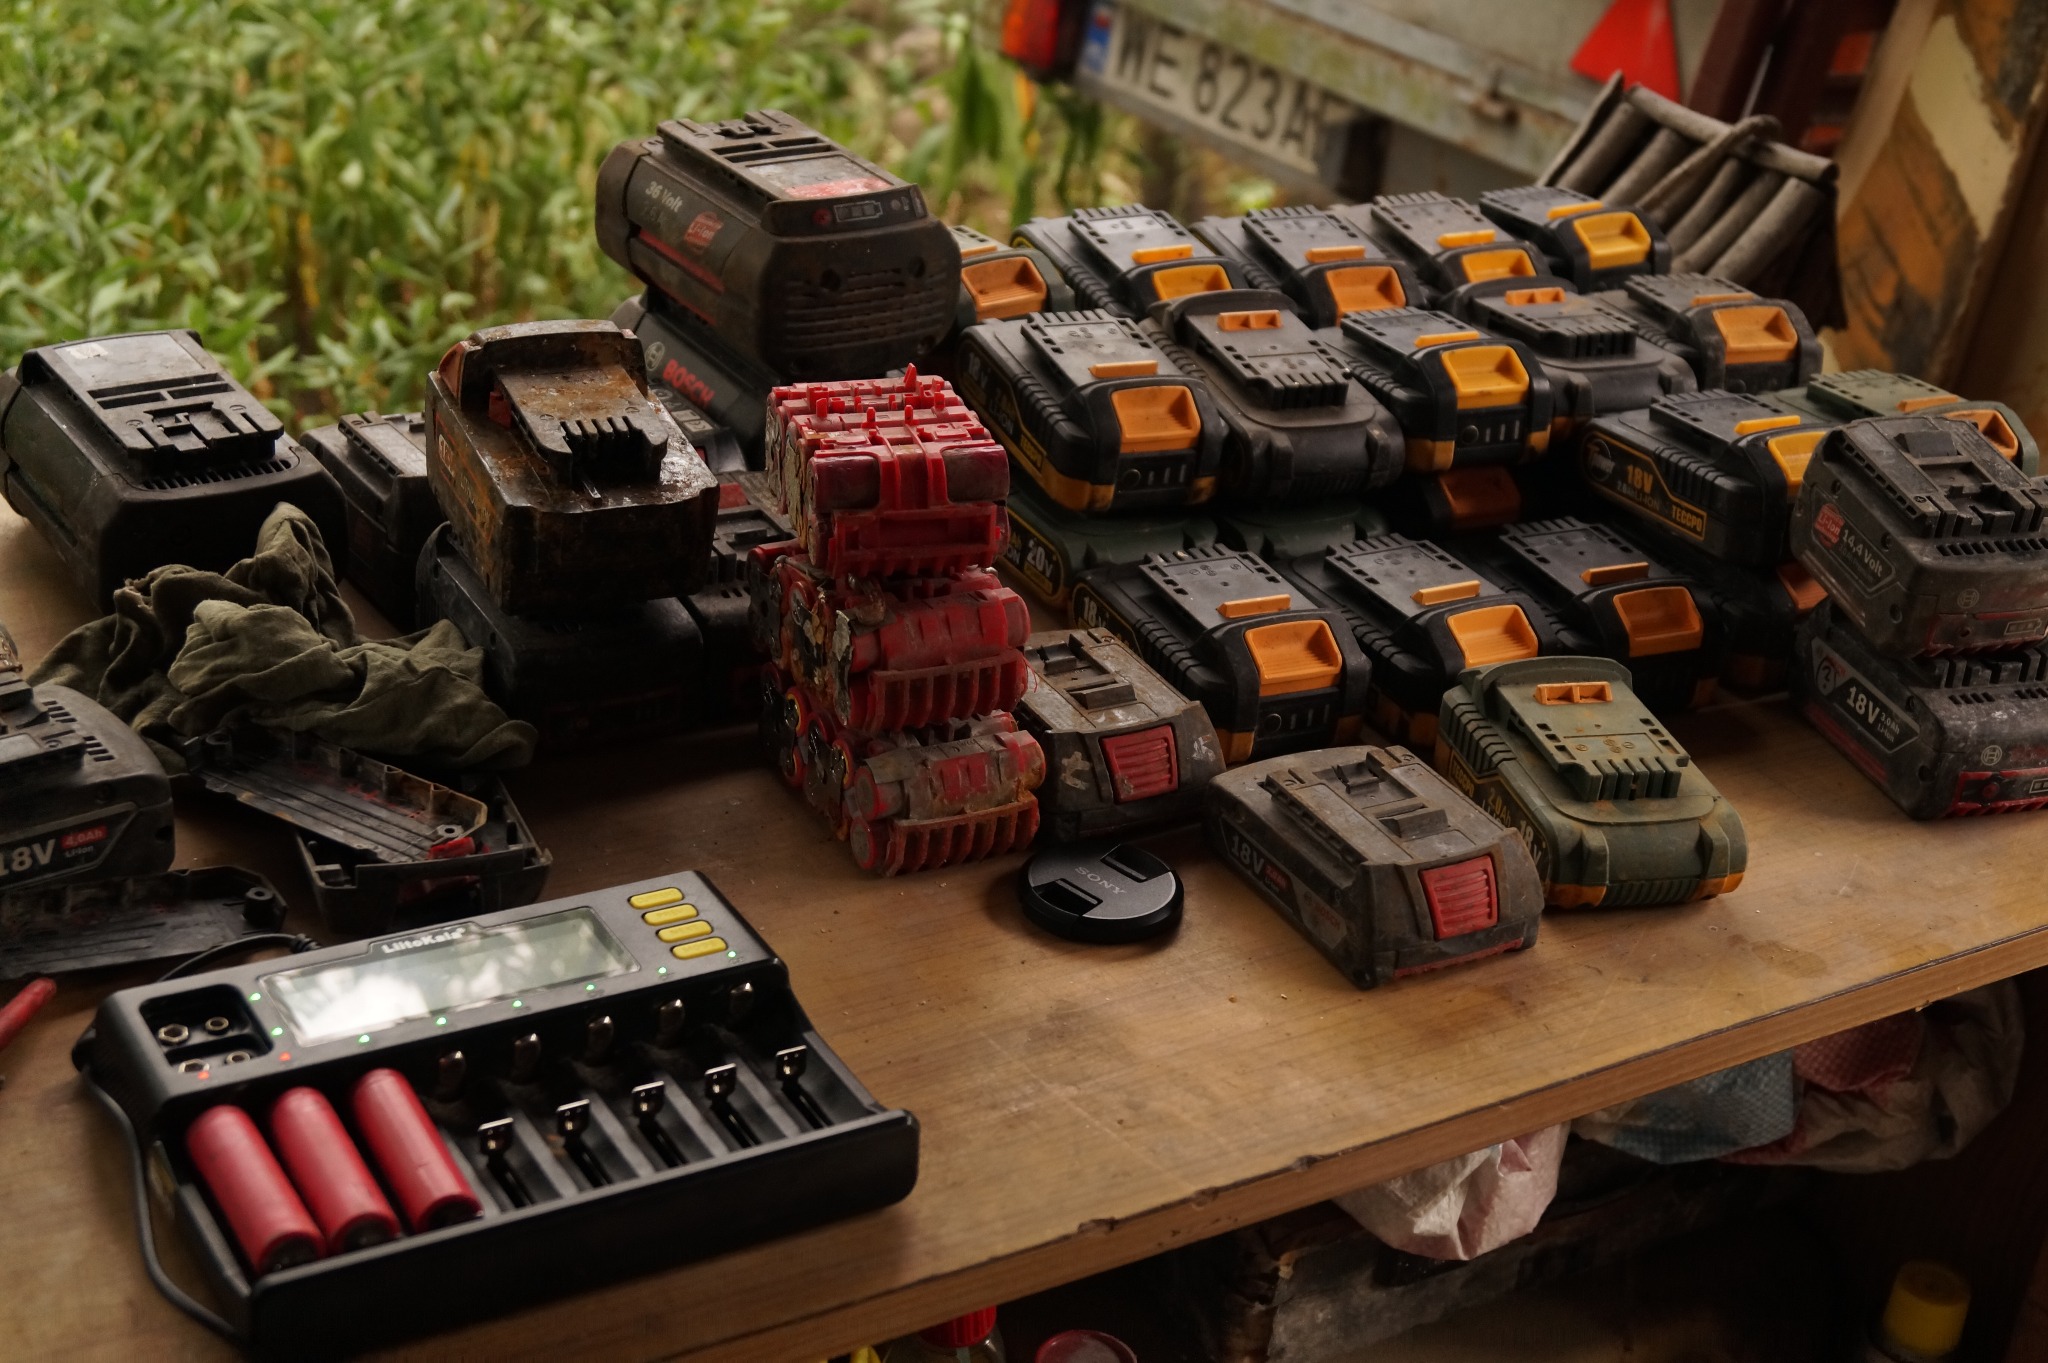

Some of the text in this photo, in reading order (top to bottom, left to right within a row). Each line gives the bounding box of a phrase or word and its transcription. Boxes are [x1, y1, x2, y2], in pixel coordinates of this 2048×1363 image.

[645, 181, 663, 199] 36
[661, 188, 683, 213] Volt
[662, 358, 717, 410] BOSCH
[1626, 463, 1654, 495] 18V
[1670, 503, 1703, 533] TECCPO
[1842, 529, 1864, 558] 14,4
[1863, 548, 1883, 578] Volt
[1845, 686, 1881, 726] 18V
[1231, 834, 1265, 875] 18V
[1074, 865, 1128, 895] SONY
